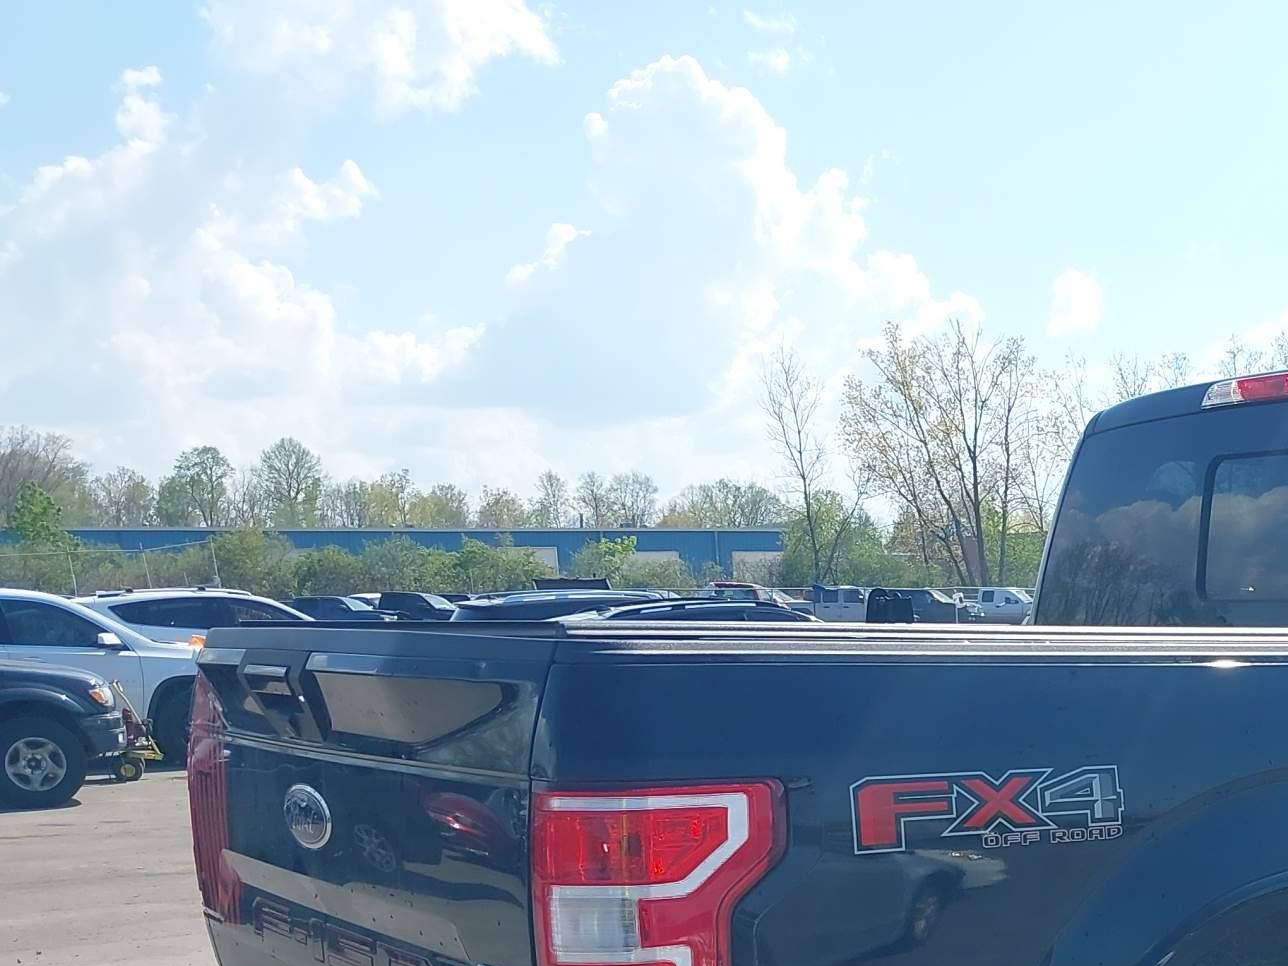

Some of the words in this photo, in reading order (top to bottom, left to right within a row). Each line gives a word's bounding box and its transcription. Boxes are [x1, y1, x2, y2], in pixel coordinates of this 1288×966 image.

[849, 764, 1125, 855] FX4
[982, 829, 1040, 849] OFF
[1050, 824, 1123, 844] ROAD
